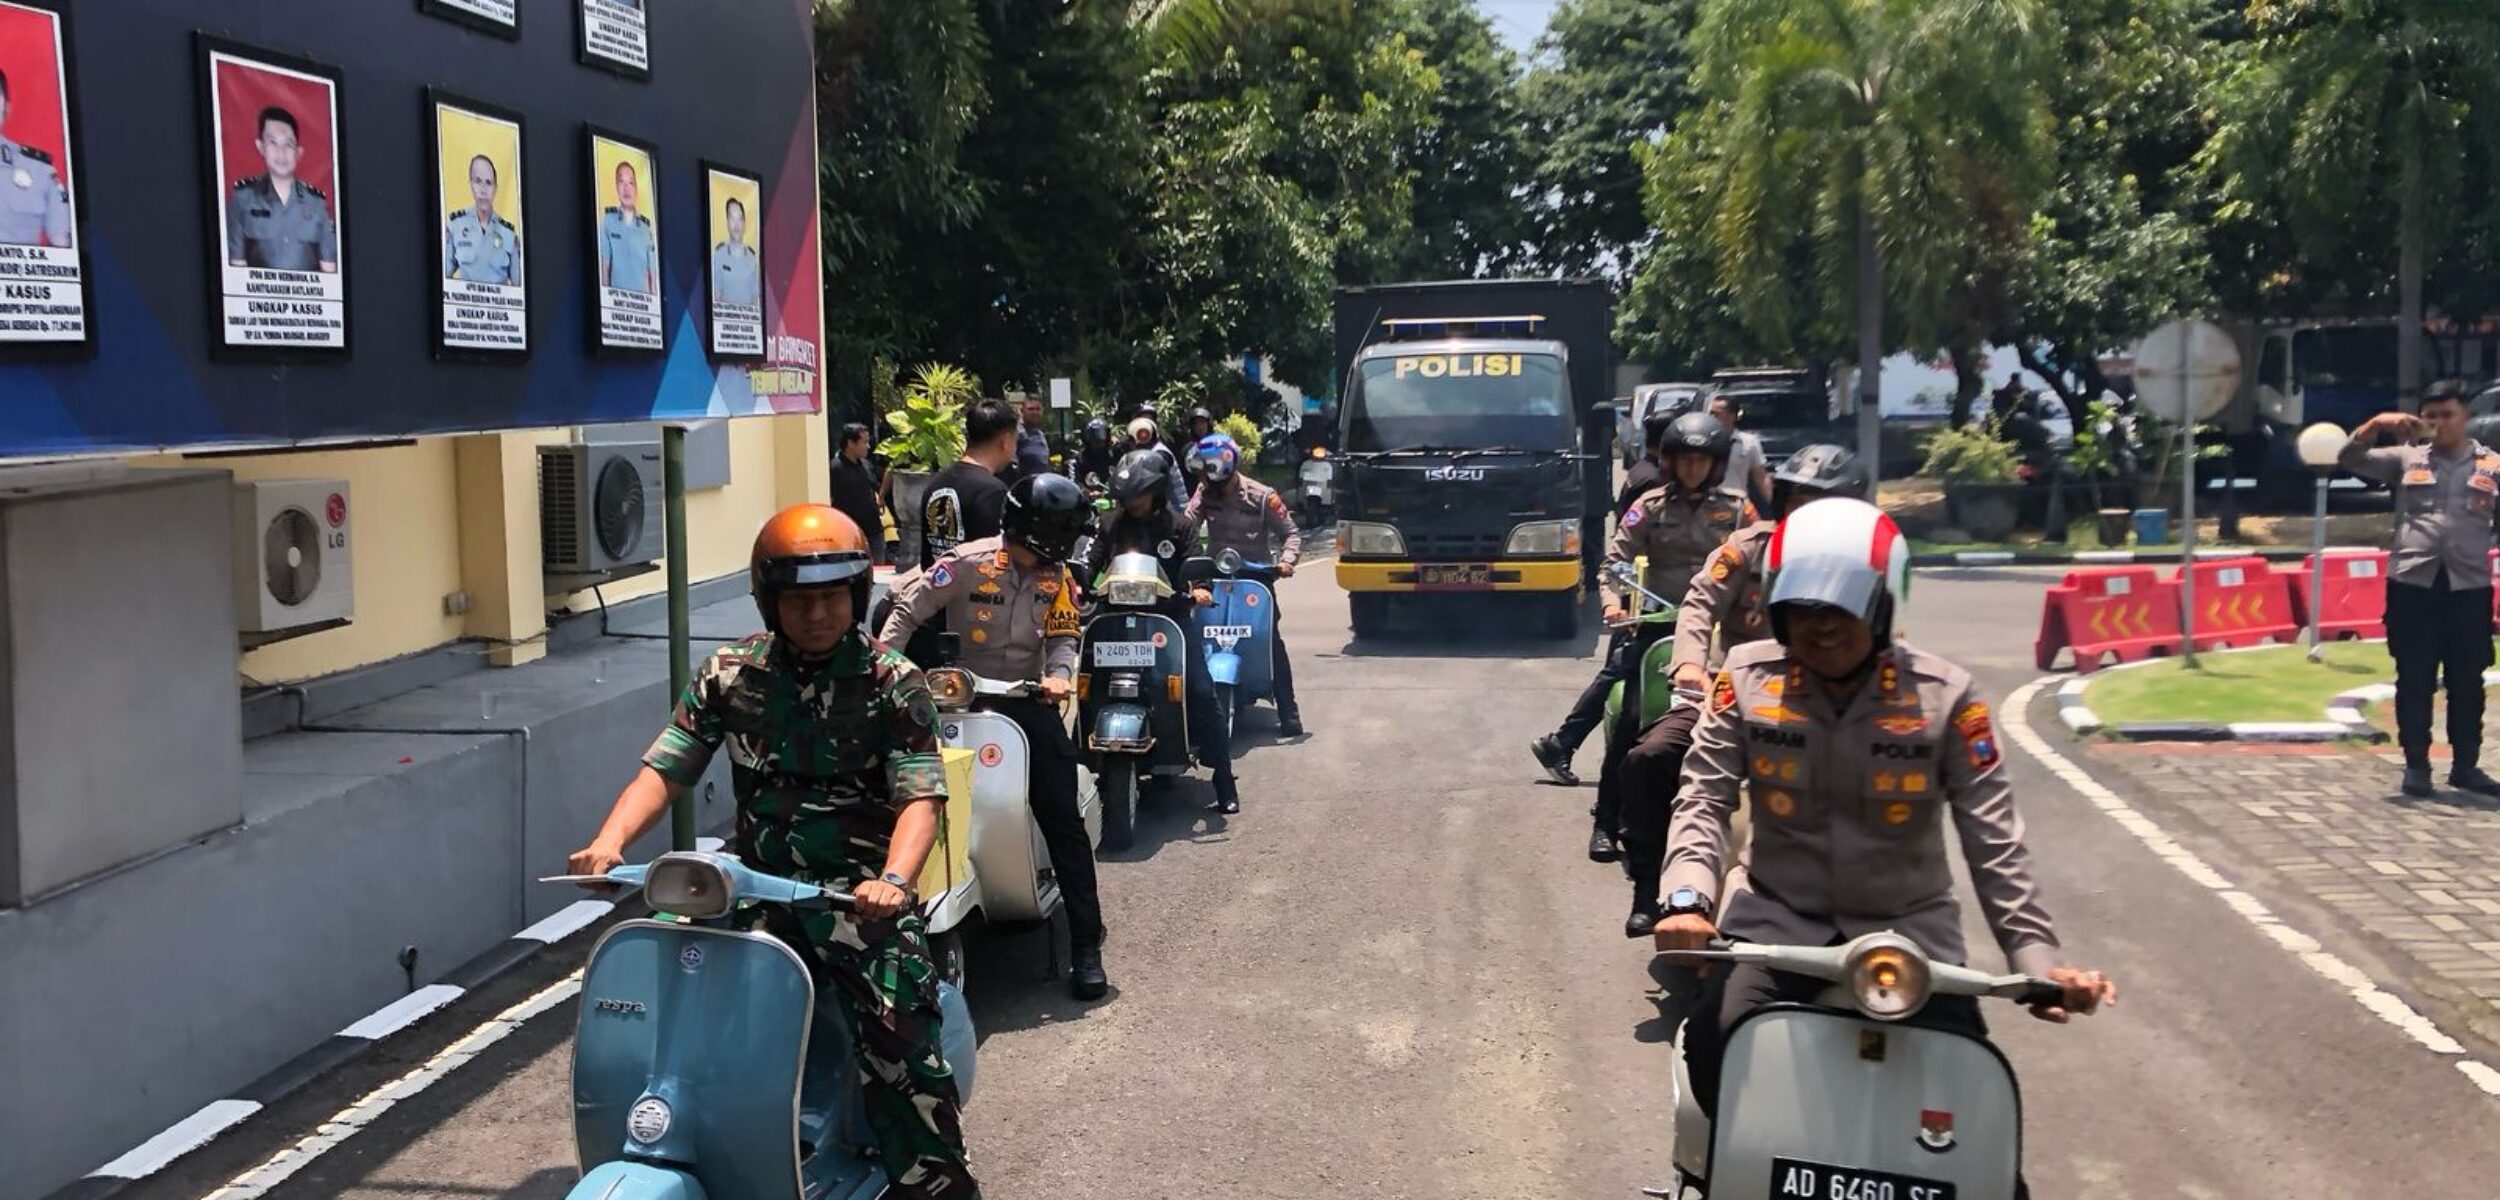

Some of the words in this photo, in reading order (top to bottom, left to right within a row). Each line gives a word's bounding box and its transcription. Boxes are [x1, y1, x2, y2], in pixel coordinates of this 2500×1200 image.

[5, 285, 52, 300] KASUS
[247, 300, 289, 314] UNGKAP
[291, 303, 323, 316] KASUS
[1395, 353, 1522, 380] POLISI
[1425, 465, 1485, 481] ISUZU
[327, 531, 345, 549] LG
[1107, 644, 1131, 657] 2405
[1870, 742, 1933, 760] POLRI
[1782, 1166, 1816, 1199] AD
[1829, 1174, 1895, 1200] 6460
